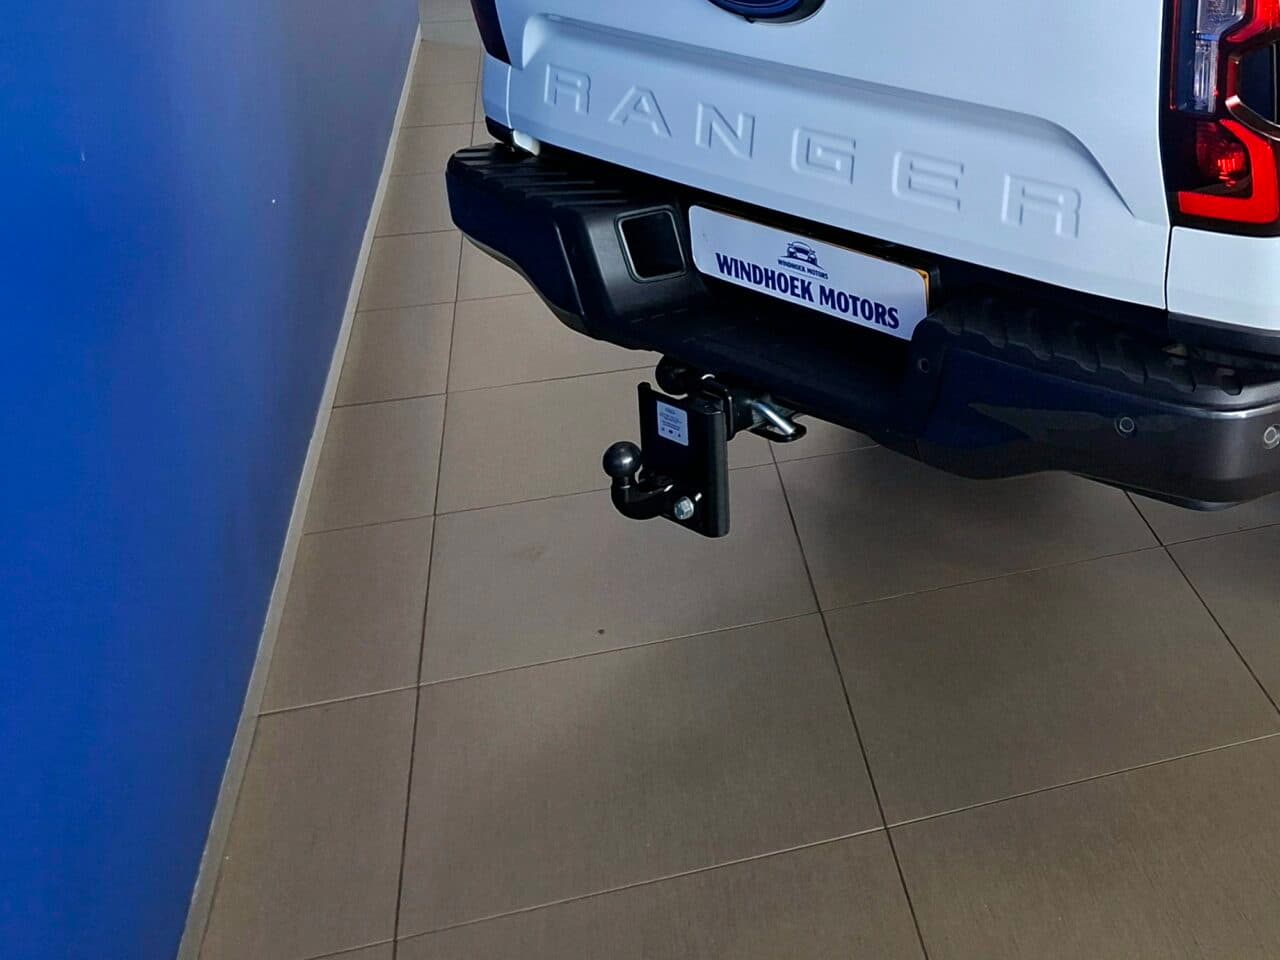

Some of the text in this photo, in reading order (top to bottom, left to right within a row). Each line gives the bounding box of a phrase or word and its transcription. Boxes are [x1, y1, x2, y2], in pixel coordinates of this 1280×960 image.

[543, 62, 1082, 239] RANGER
[715, 252, 901, 330] WINDHOEK MOTORS
